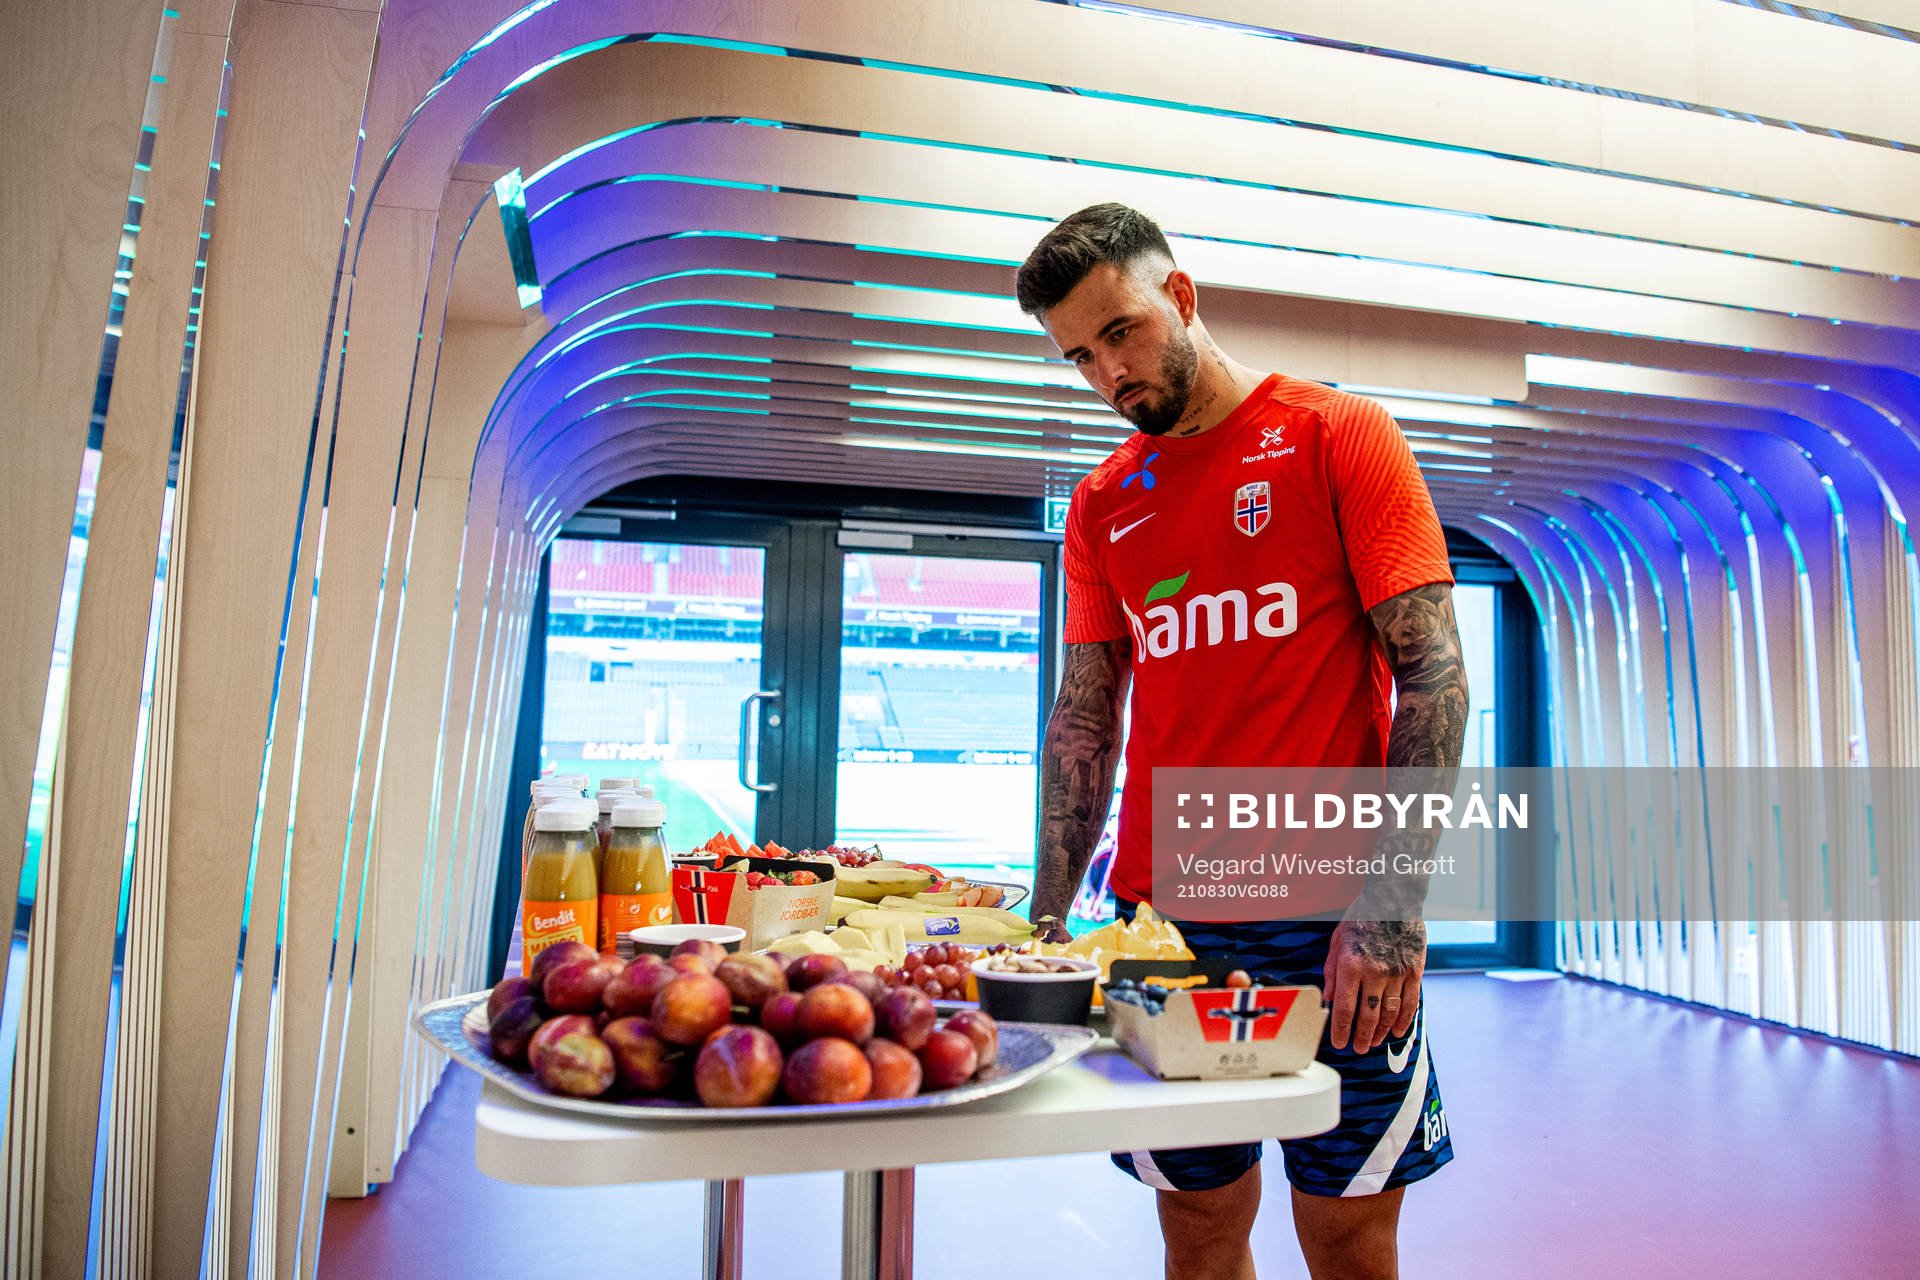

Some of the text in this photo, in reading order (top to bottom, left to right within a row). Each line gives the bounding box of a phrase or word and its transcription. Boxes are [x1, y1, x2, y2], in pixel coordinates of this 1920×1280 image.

[1242, 445, 1296, 464] Norsk Tipping
[534, 909, 576, 931] Bendit
[779, 906, 819, 921] JORDBÆR
